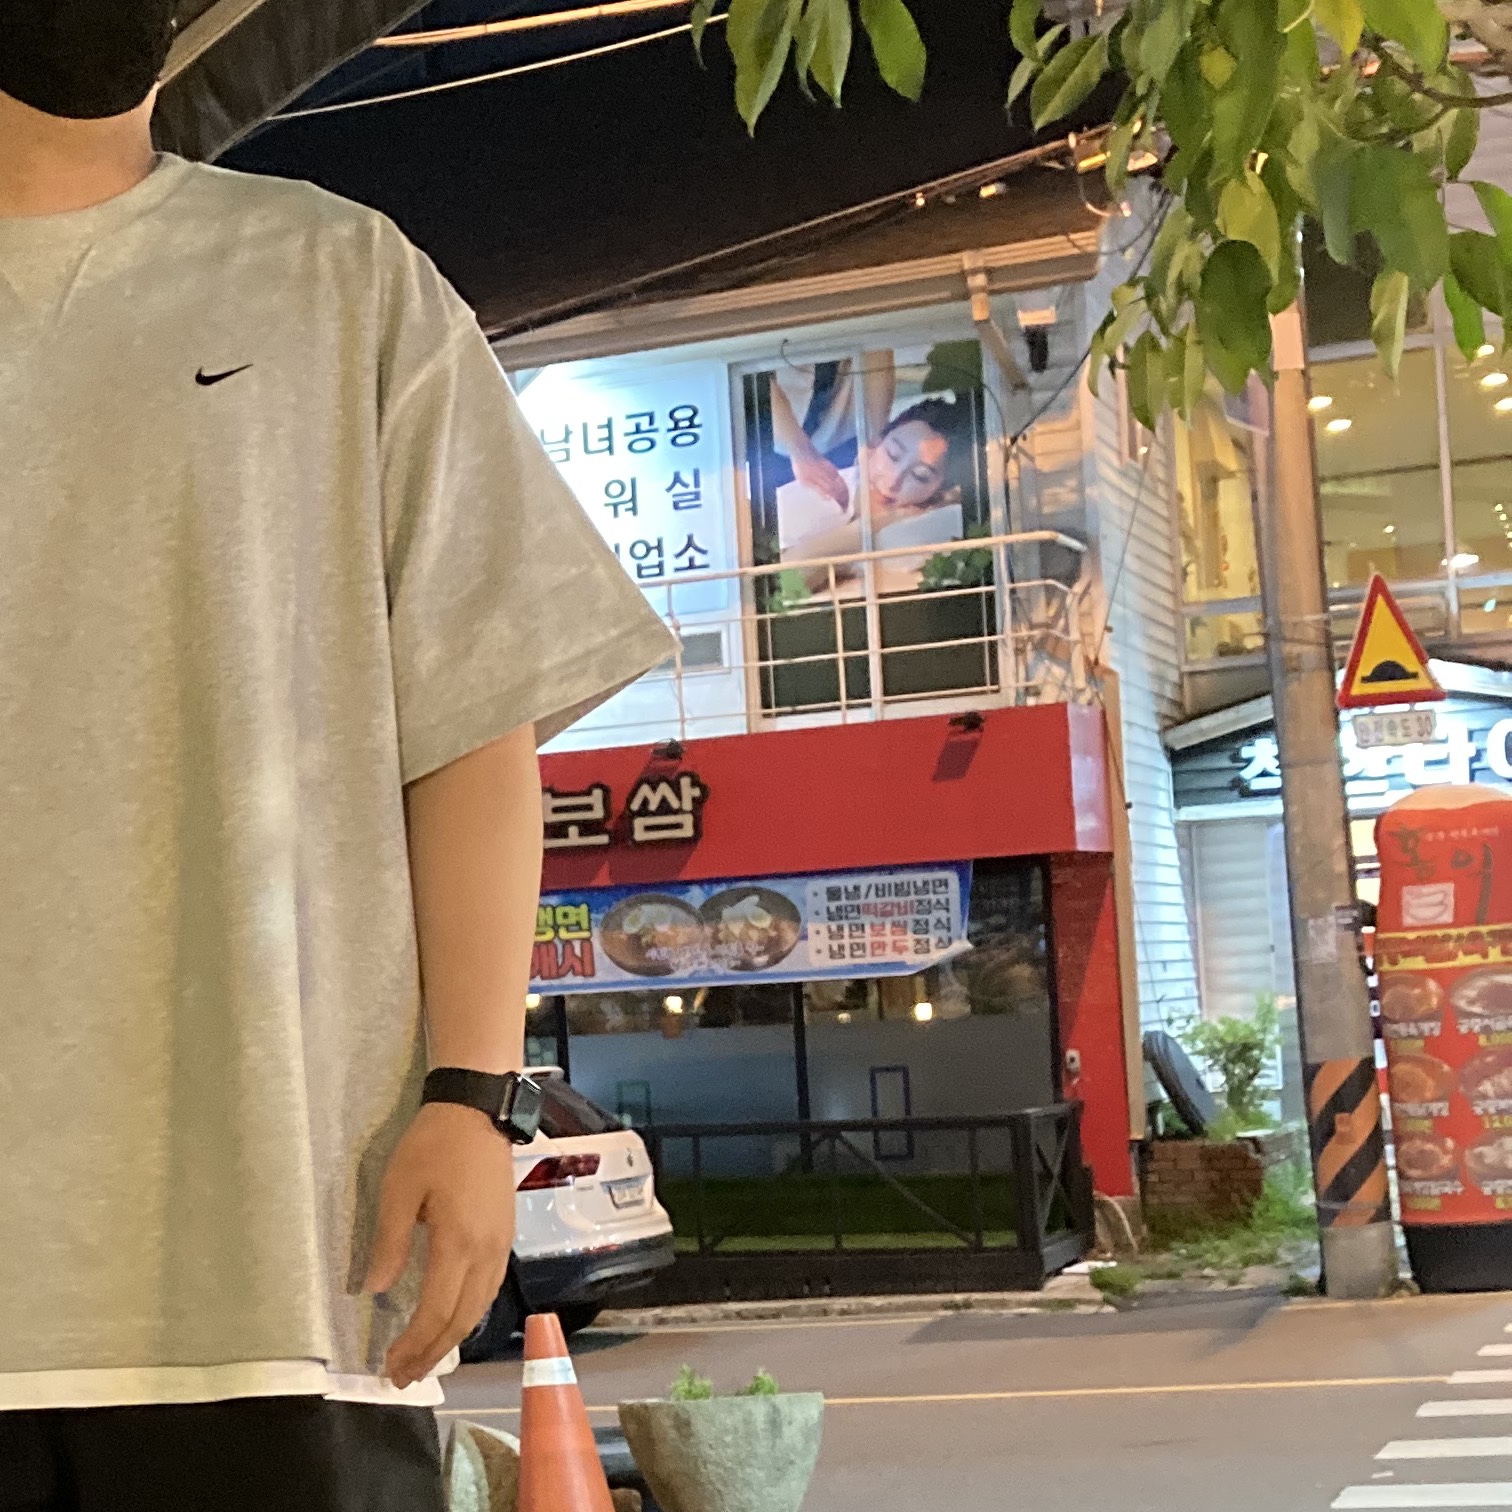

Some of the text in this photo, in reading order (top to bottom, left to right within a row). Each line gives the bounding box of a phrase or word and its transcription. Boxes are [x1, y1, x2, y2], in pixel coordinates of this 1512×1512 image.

[540, 404, 703, 465] 남녀공용
[614, 532, 710, 579] 업소
[542, 774, 704, 850] 보쌈
